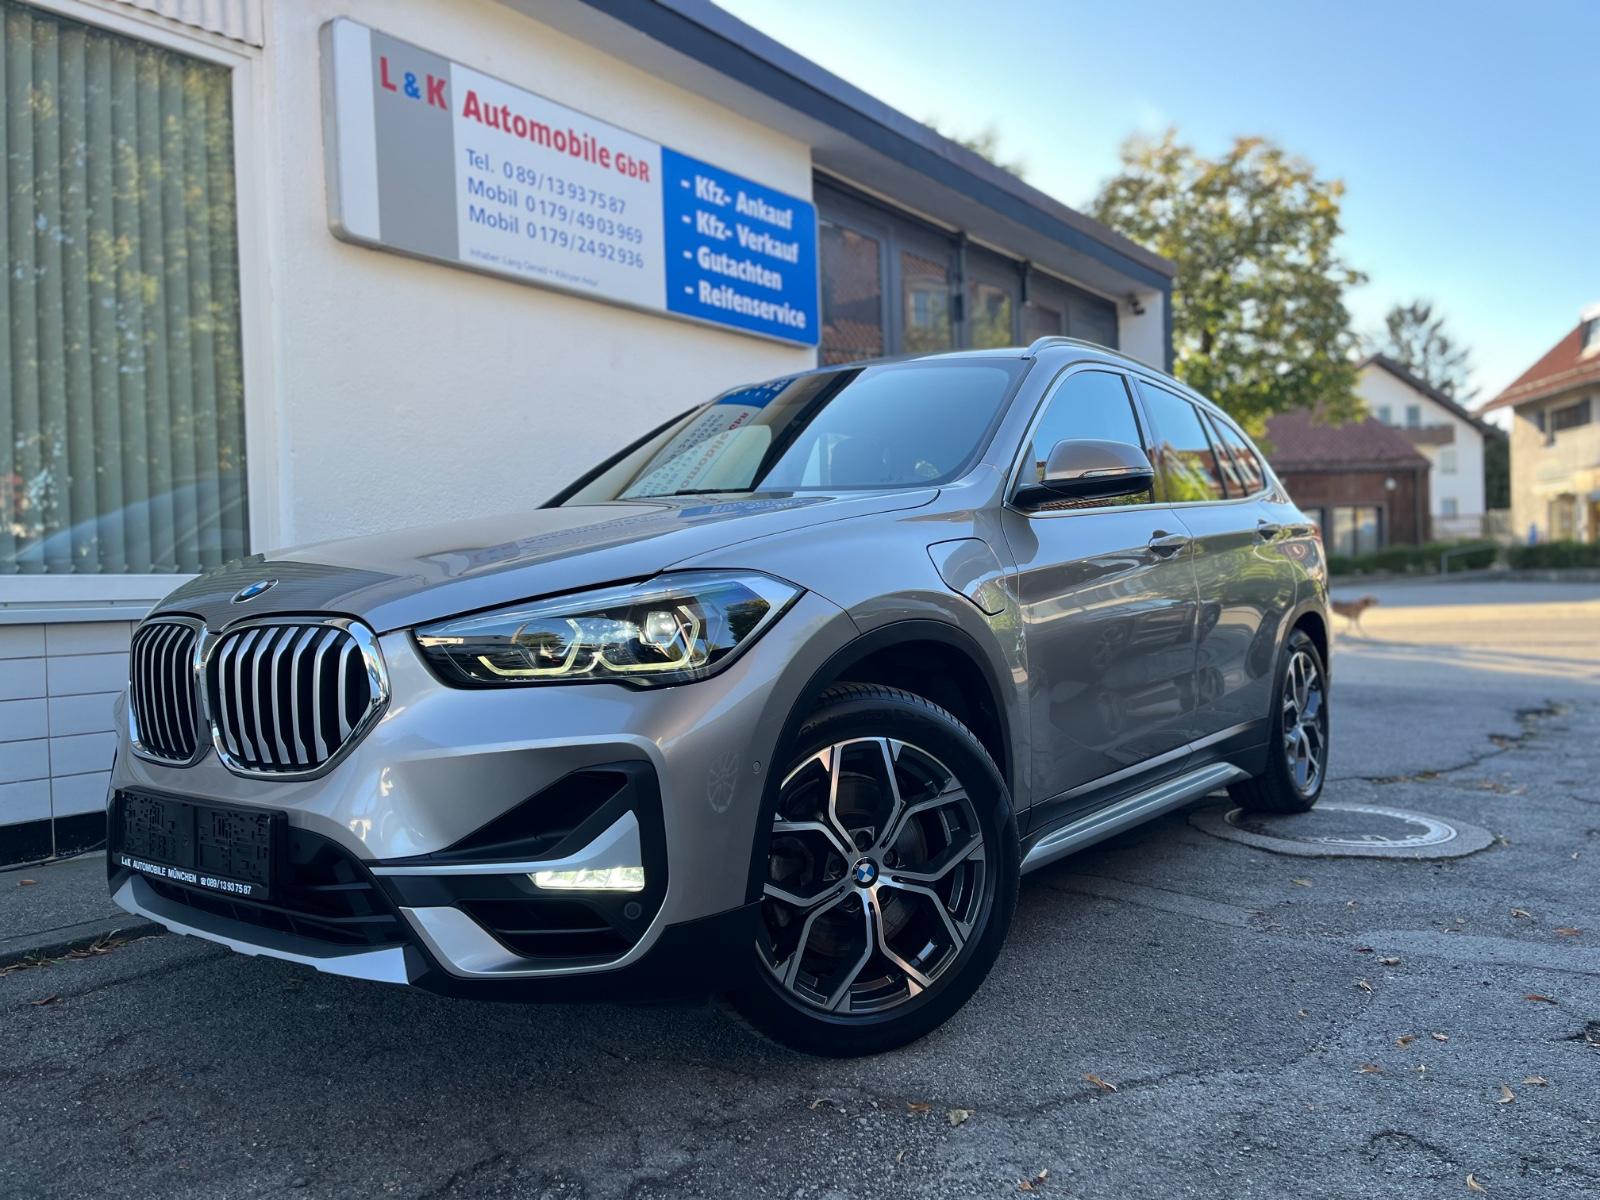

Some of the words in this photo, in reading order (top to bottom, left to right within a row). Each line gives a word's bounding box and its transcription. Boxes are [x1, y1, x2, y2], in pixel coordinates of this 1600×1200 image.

[380, 56, 397, 92] L
[404, 72, 421, 99] &
[427, 74, 448, 111] K
[462, 90, 611, 169] Automobile
[615, 152, 650, 183] GbR
[466, 148, 495, 174] Tel.
[467, 177, 518, 207] Mobil
[735, 191, 793, 230] Ankauf
[469, 205, 519, 234] Mobil
[735, 223, 799, 264] Verkauf
[697, 245, 782, 291] Gutachten
[698, 279, 806, 329] Reifenservice
[133, 860, 166, 876] AUTOMOBILE
[167, 868, 197, 883] MÜNCHEN
